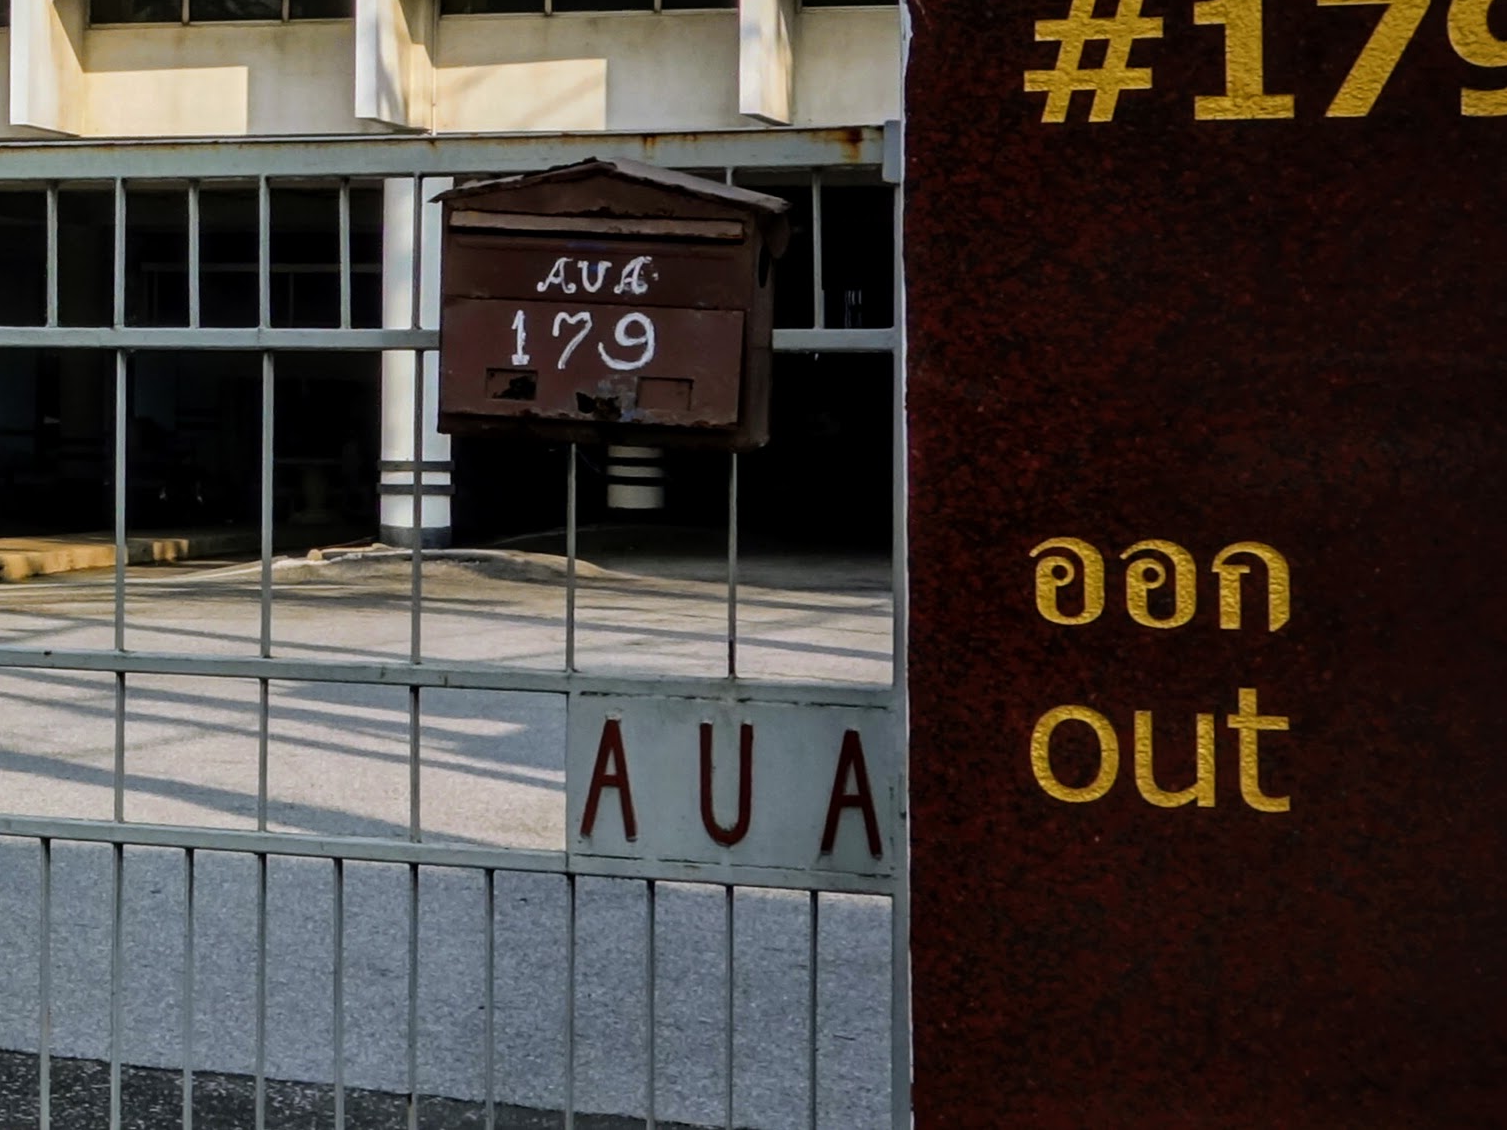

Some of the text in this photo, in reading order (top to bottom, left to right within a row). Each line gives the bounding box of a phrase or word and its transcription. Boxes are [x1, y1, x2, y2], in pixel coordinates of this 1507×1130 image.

[510, 309, 657, 371] 179
[1028, 536, 1291, 632] ออก
[579, 710, 884, 860] AUA
[1029, 687, 1291, 812] out
